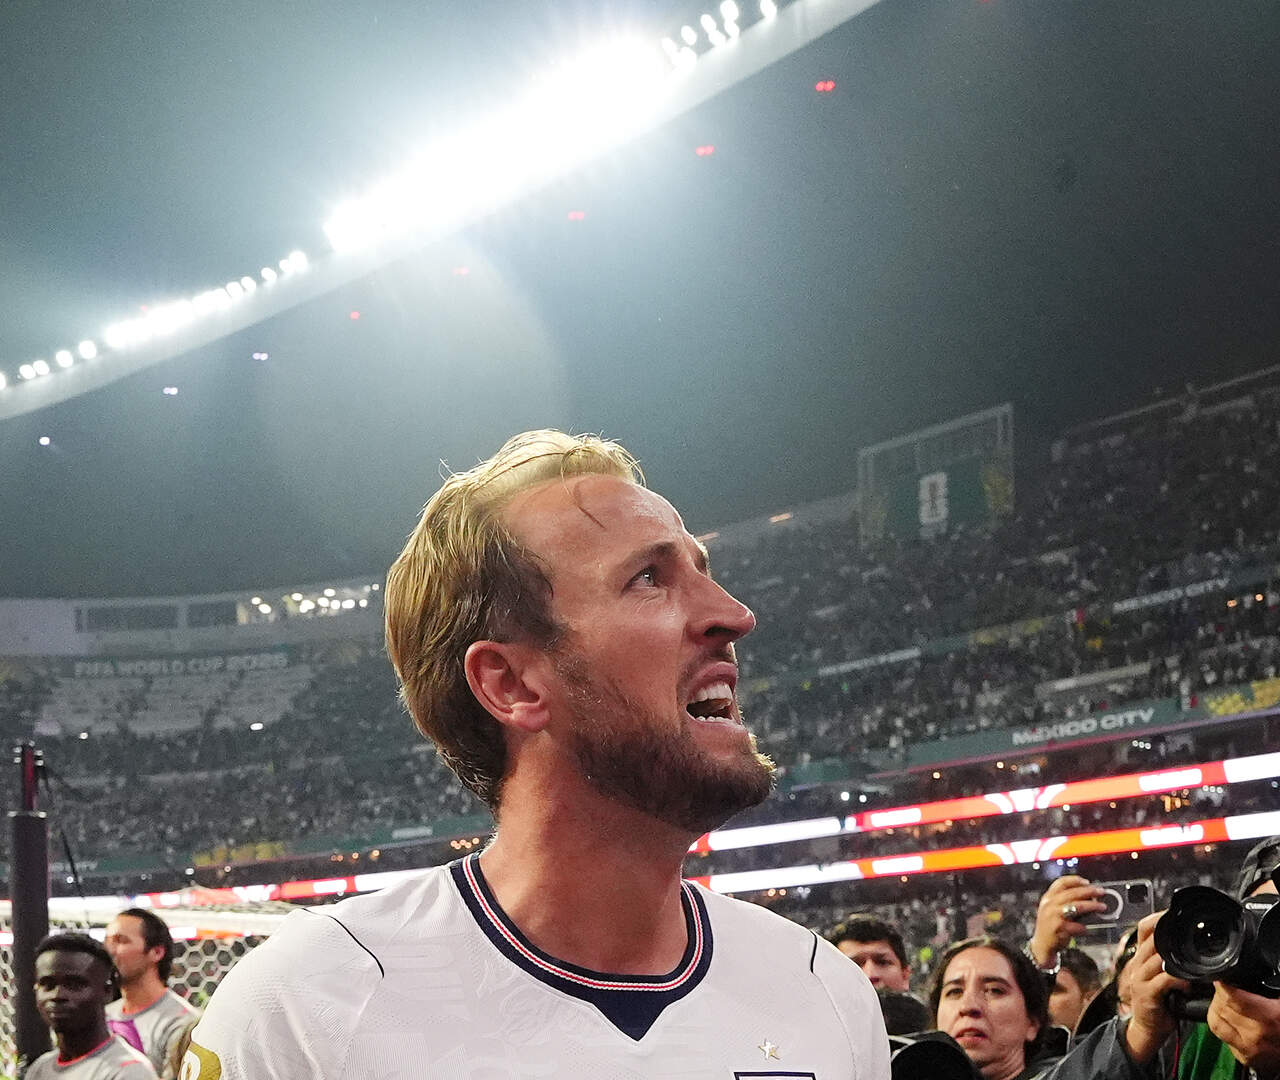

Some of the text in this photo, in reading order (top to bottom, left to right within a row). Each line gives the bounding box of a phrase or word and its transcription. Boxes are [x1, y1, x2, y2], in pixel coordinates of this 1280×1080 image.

[74, 660, 114, 677] FIFA
[119, 657, 185, 675] WORLD
[187, 655, 225, 673] CUP
[1011, 706, 1156, 746] MEXICO CITY
